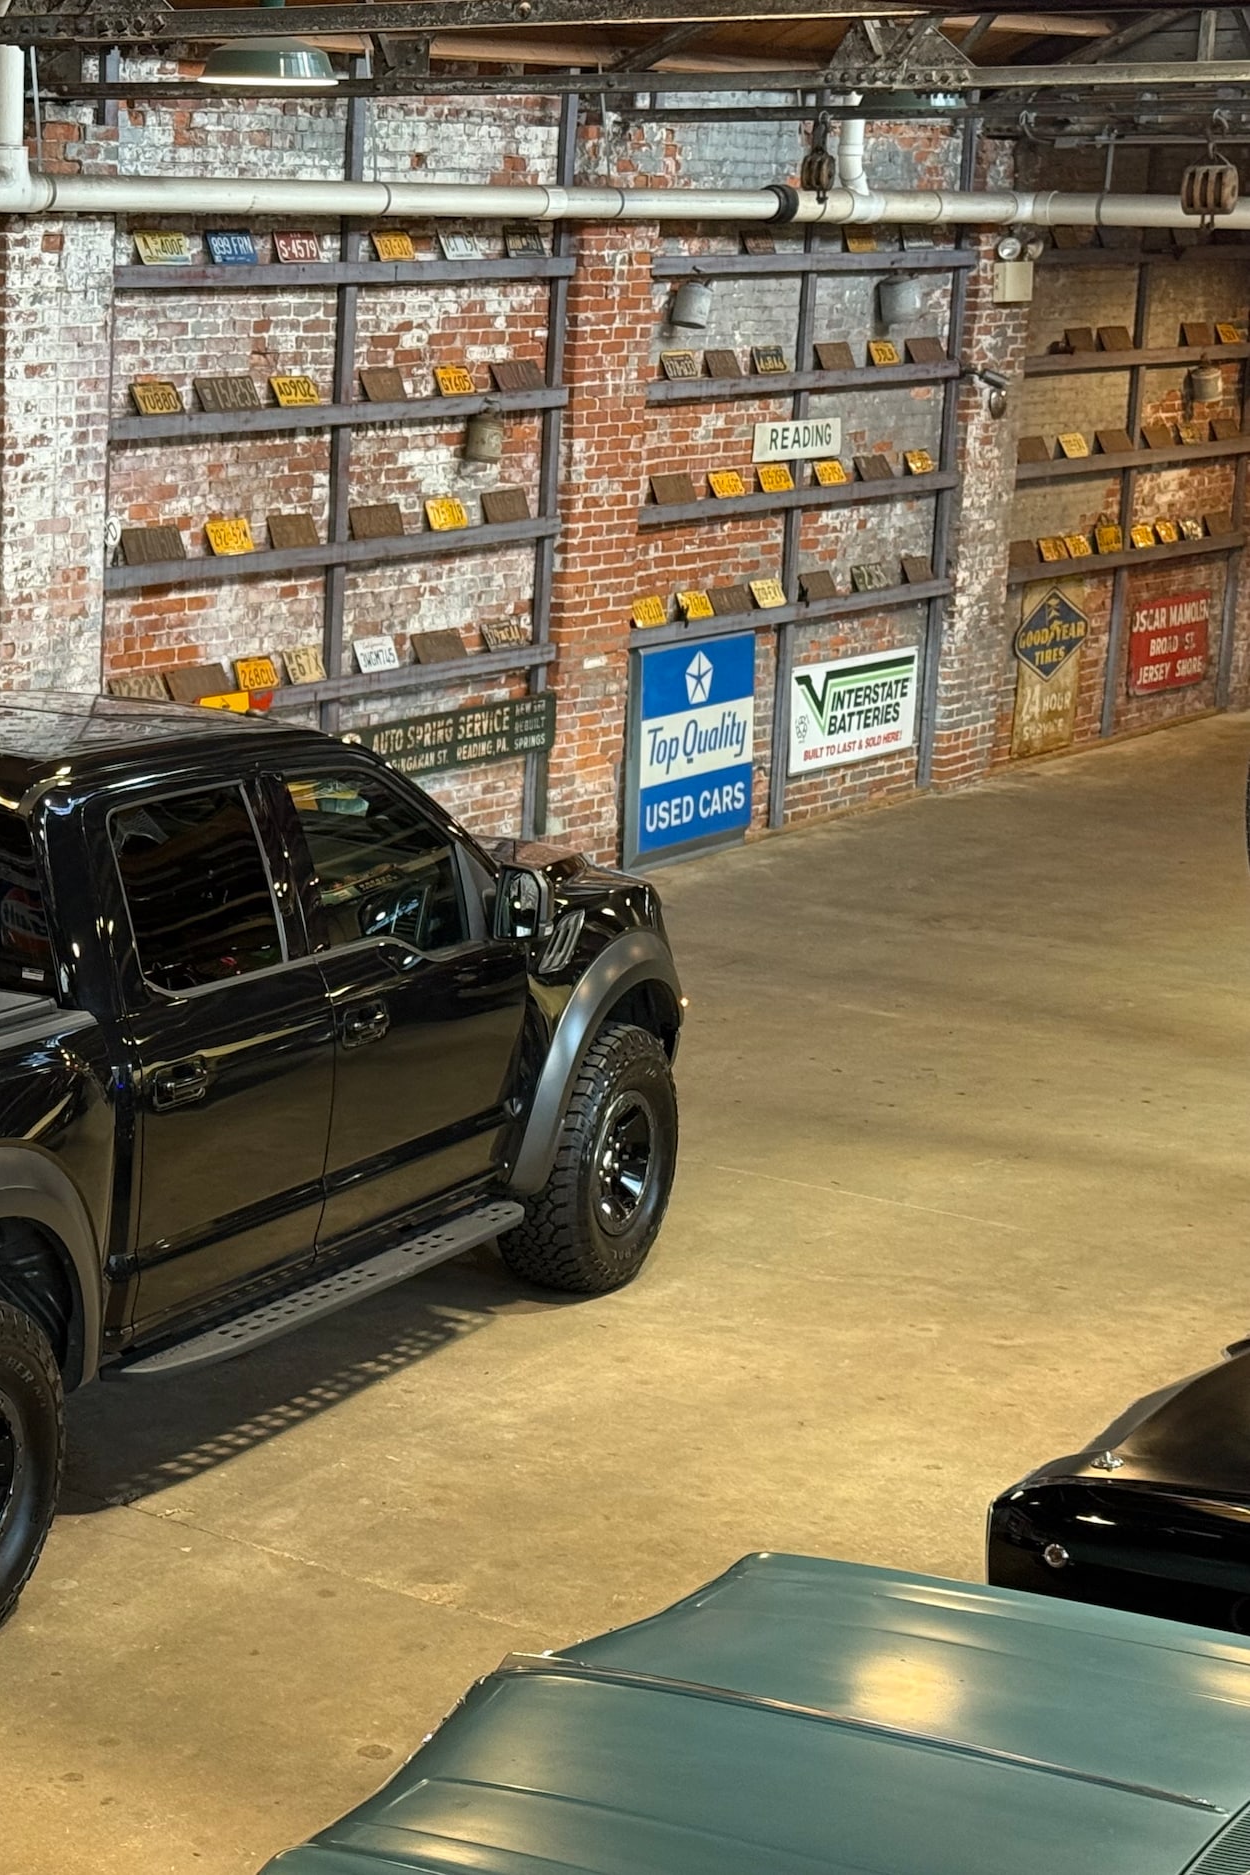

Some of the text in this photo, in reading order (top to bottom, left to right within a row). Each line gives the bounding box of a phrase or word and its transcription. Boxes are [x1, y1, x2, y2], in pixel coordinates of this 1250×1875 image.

[211, 235, 254, 255] 899 FRN
[277, 379, 316, 399] AD902
[440, 375, 472, 391] GY605
[138, 392, 178, 411] YU880
[768, 422, 832, 451] READING
[1019, 620, 1086, 649] GOODYEAR
[1150, 635, 1179, 657] BROAD
[1034, 645, 1066, 667] TIRES
[1136, 655, 1203, 685] JERSEY SHORE
[831, 677, 911, 712] INTERSTATE
[1021, 684, 1072, 723] 24 HOUR
[372, 707, 510, 755] AUTO SPRING SERVICE
[514, 716, 546, 734] REBUILT
[827, 702, 900, 736] BATTERIES
[514, 733, 546, 751] SPRINGS
[648, 711, 747, 775] Top Quality
[803, 746, 825, 761] BUILT
[826, 743, 836, 757] TO
[837, 740, 856, 755] LAST
[865, 734, 882, 749] SOLD
[645, 781, 745, 833] USED CARS
